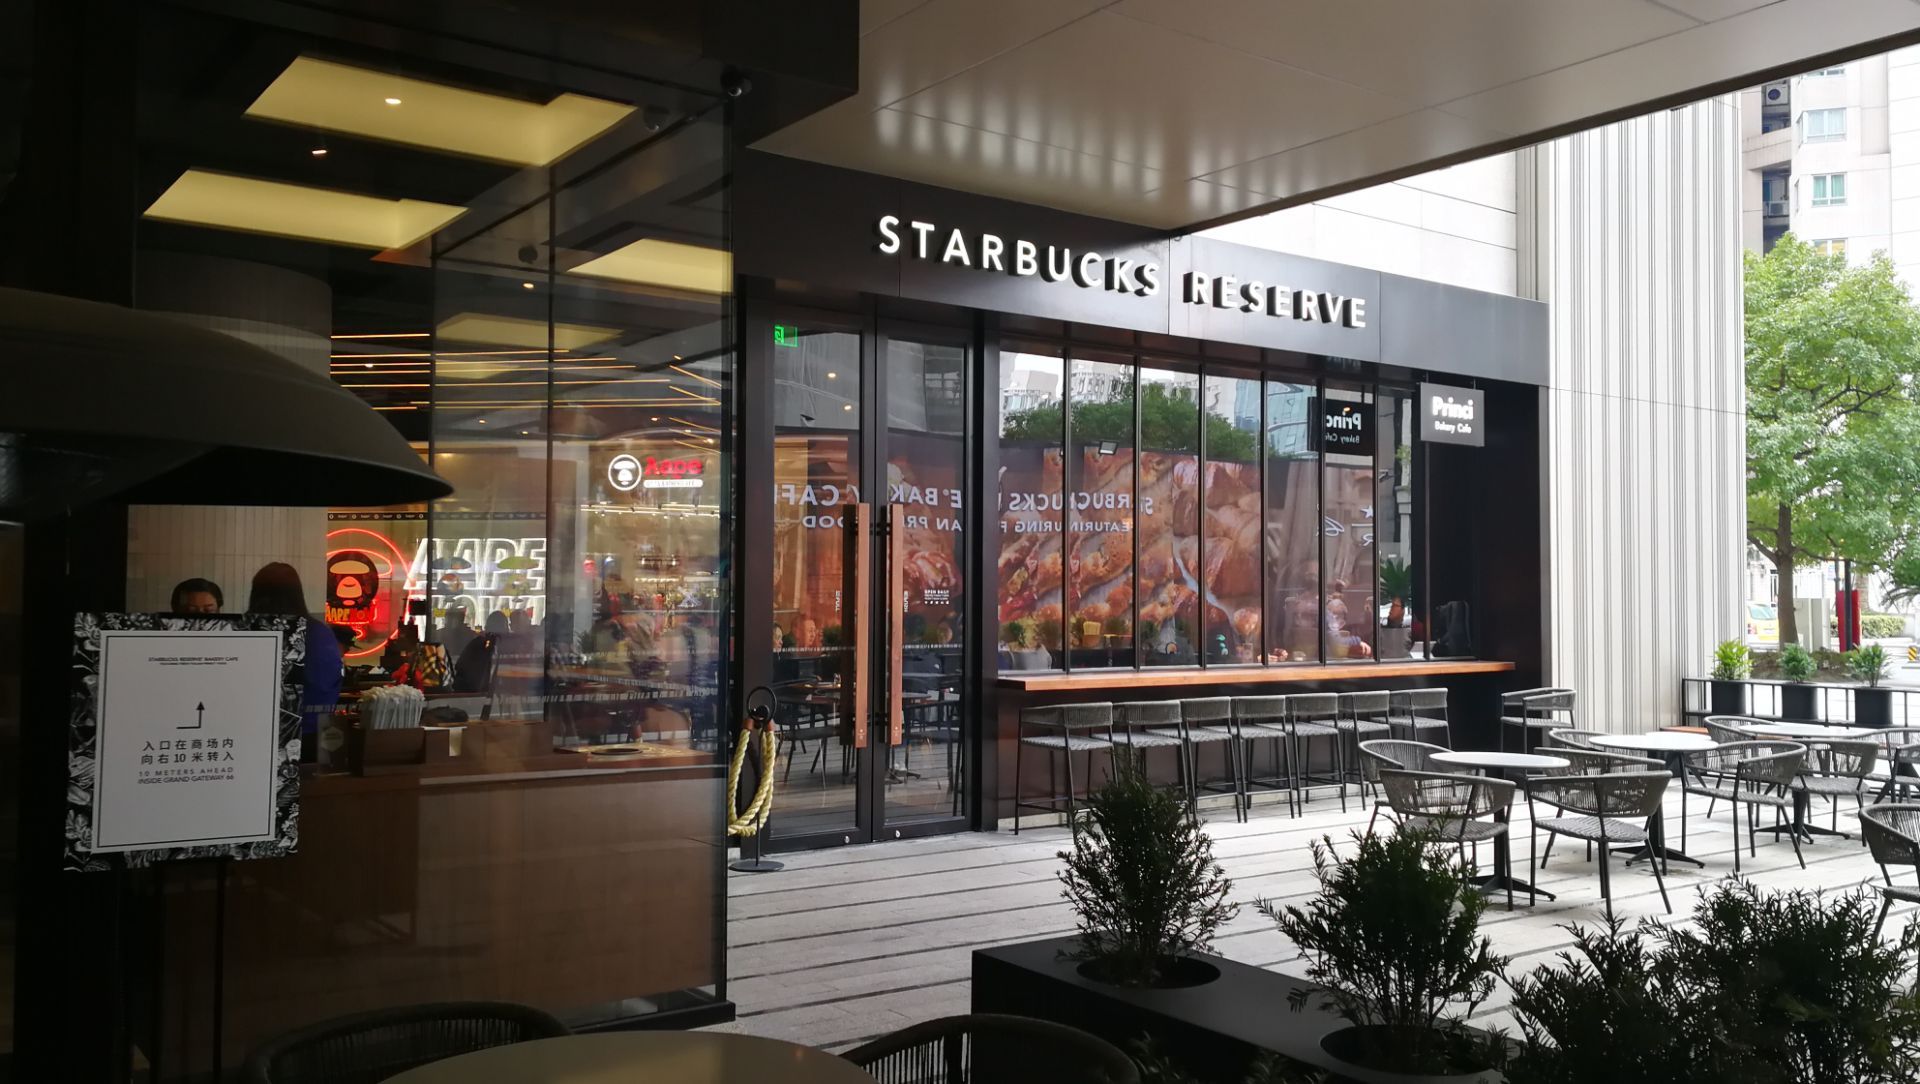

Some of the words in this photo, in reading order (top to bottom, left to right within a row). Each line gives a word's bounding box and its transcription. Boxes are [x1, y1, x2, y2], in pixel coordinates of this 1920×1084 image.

[878, 215, 1160, 296] STARBUCKS
[1187, 270, 1367, 329] RESERVE
[1432, 396, 1474, 420] Princi
[1434, 420, 1456, 434] Bakery
[1457, 422, 1472, 434] Cafe
[644, 456, 703, 479] Aape
[403, 537, 547, 591] AAPE
[142, 737, 234, 752] 入口在商场内
[140, 751, 235, 765] 向右10米转入
[155, 768, 195, 776] METERS
[199, 766, 234, 774] AHEAD
